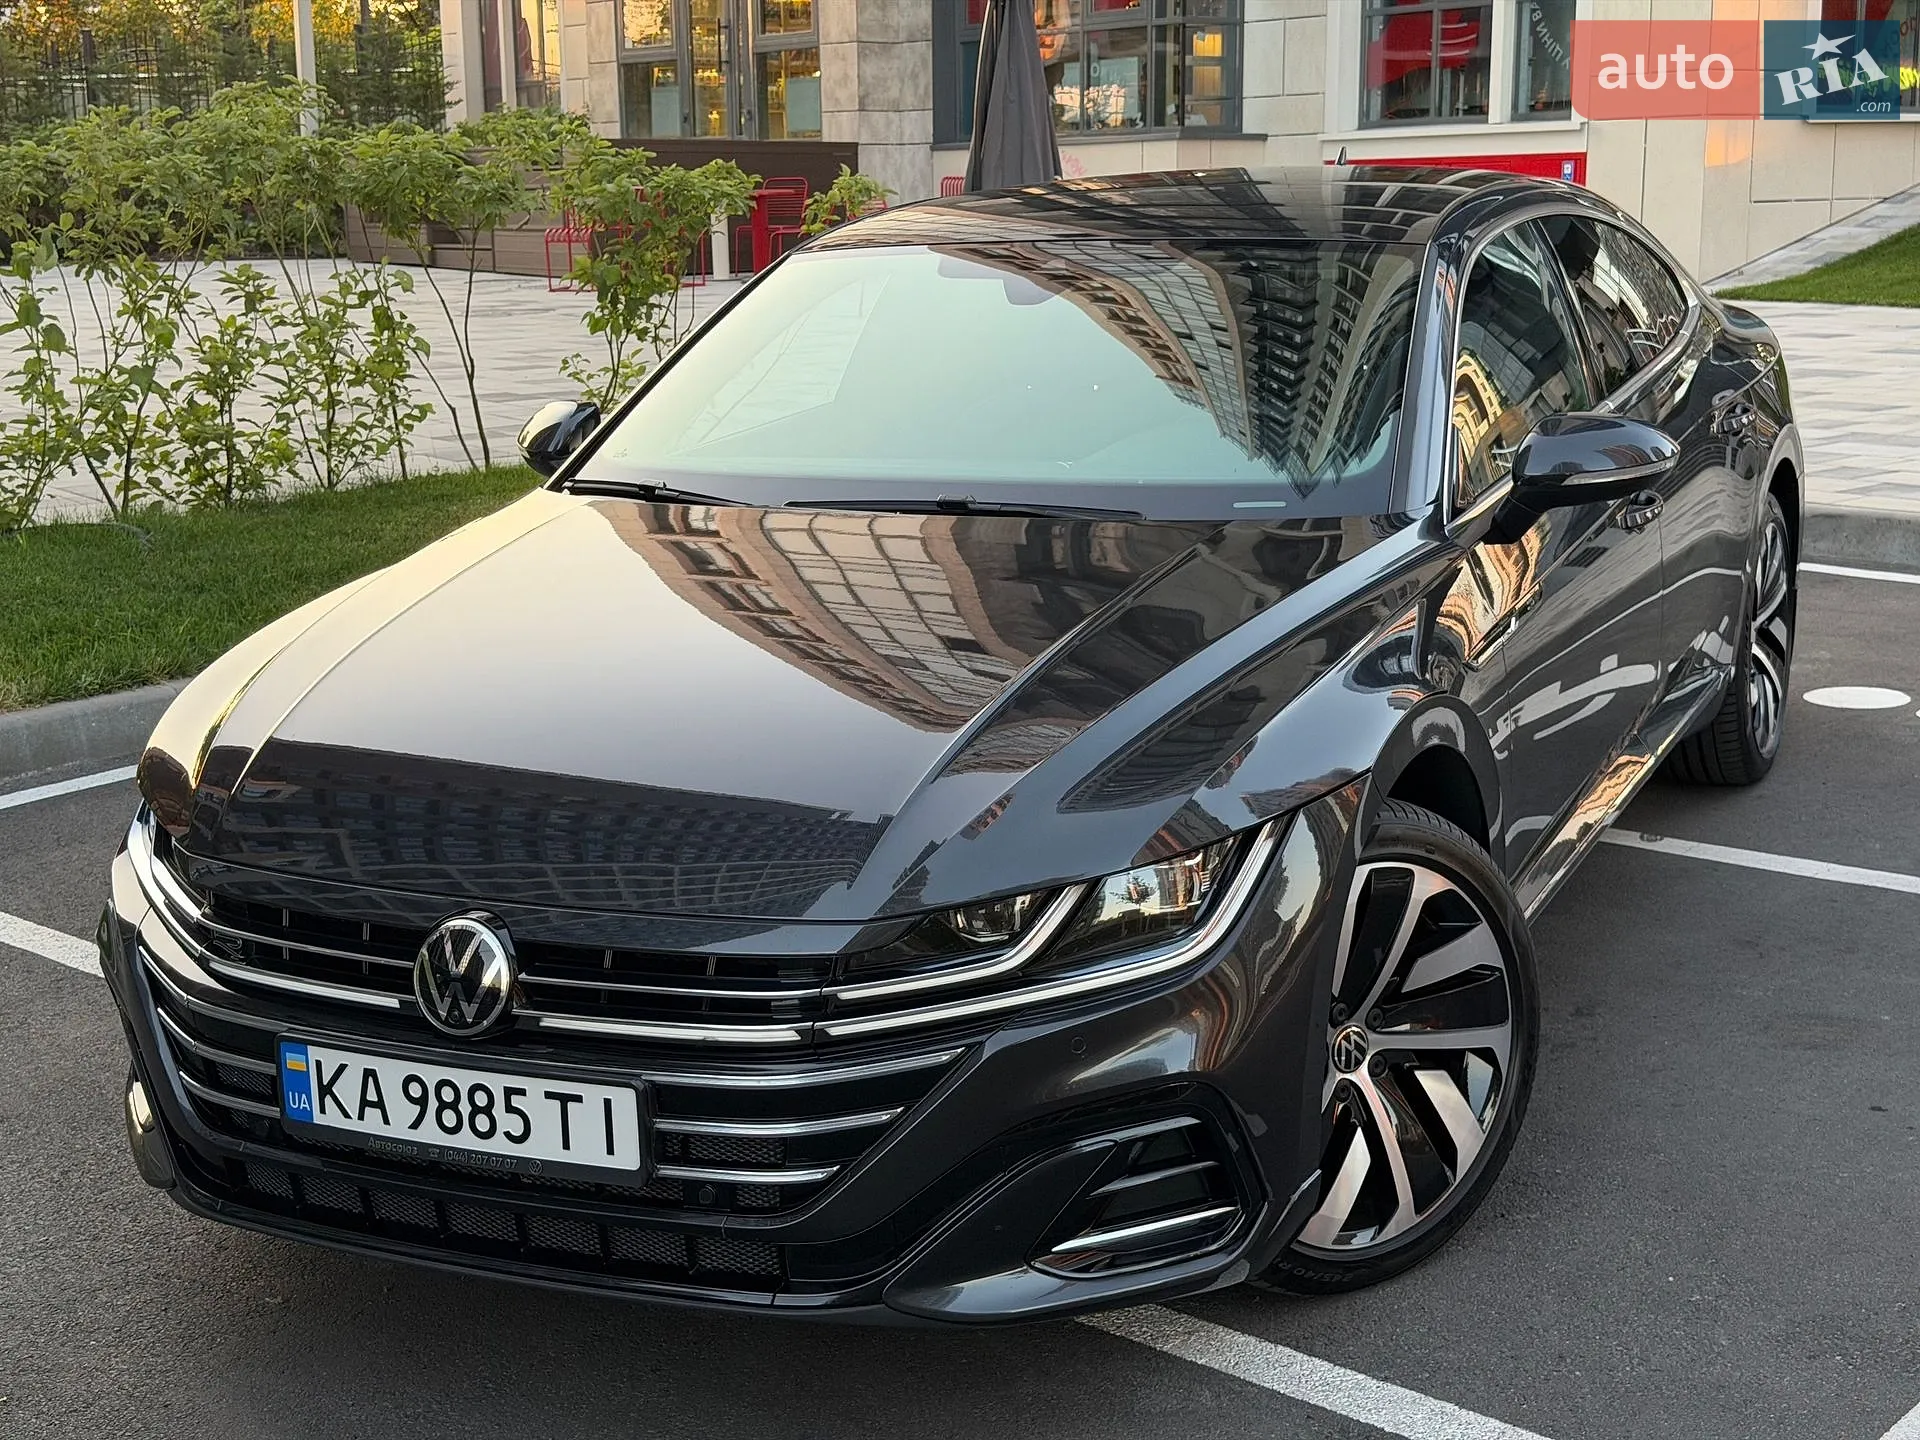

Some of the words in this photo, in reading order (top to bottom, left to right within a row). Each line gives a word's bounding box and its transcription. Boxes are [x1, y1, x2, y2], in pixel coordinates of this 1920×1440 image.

[288, 1090, 312, 1113] UA
[315, 1059, 391, 1127] KA
[401, 1073, 532, 1145] 9885
[544, 1089, 615, 1156] TI
[368, 1136, 418, 1156] Автосоюз
[444, 1149, 469, 1163] (044)
[470, 1153, 487, 1166] 207
[490, 1156, 503, 1167] 07
[504, 1158, 518, 1170] 07
